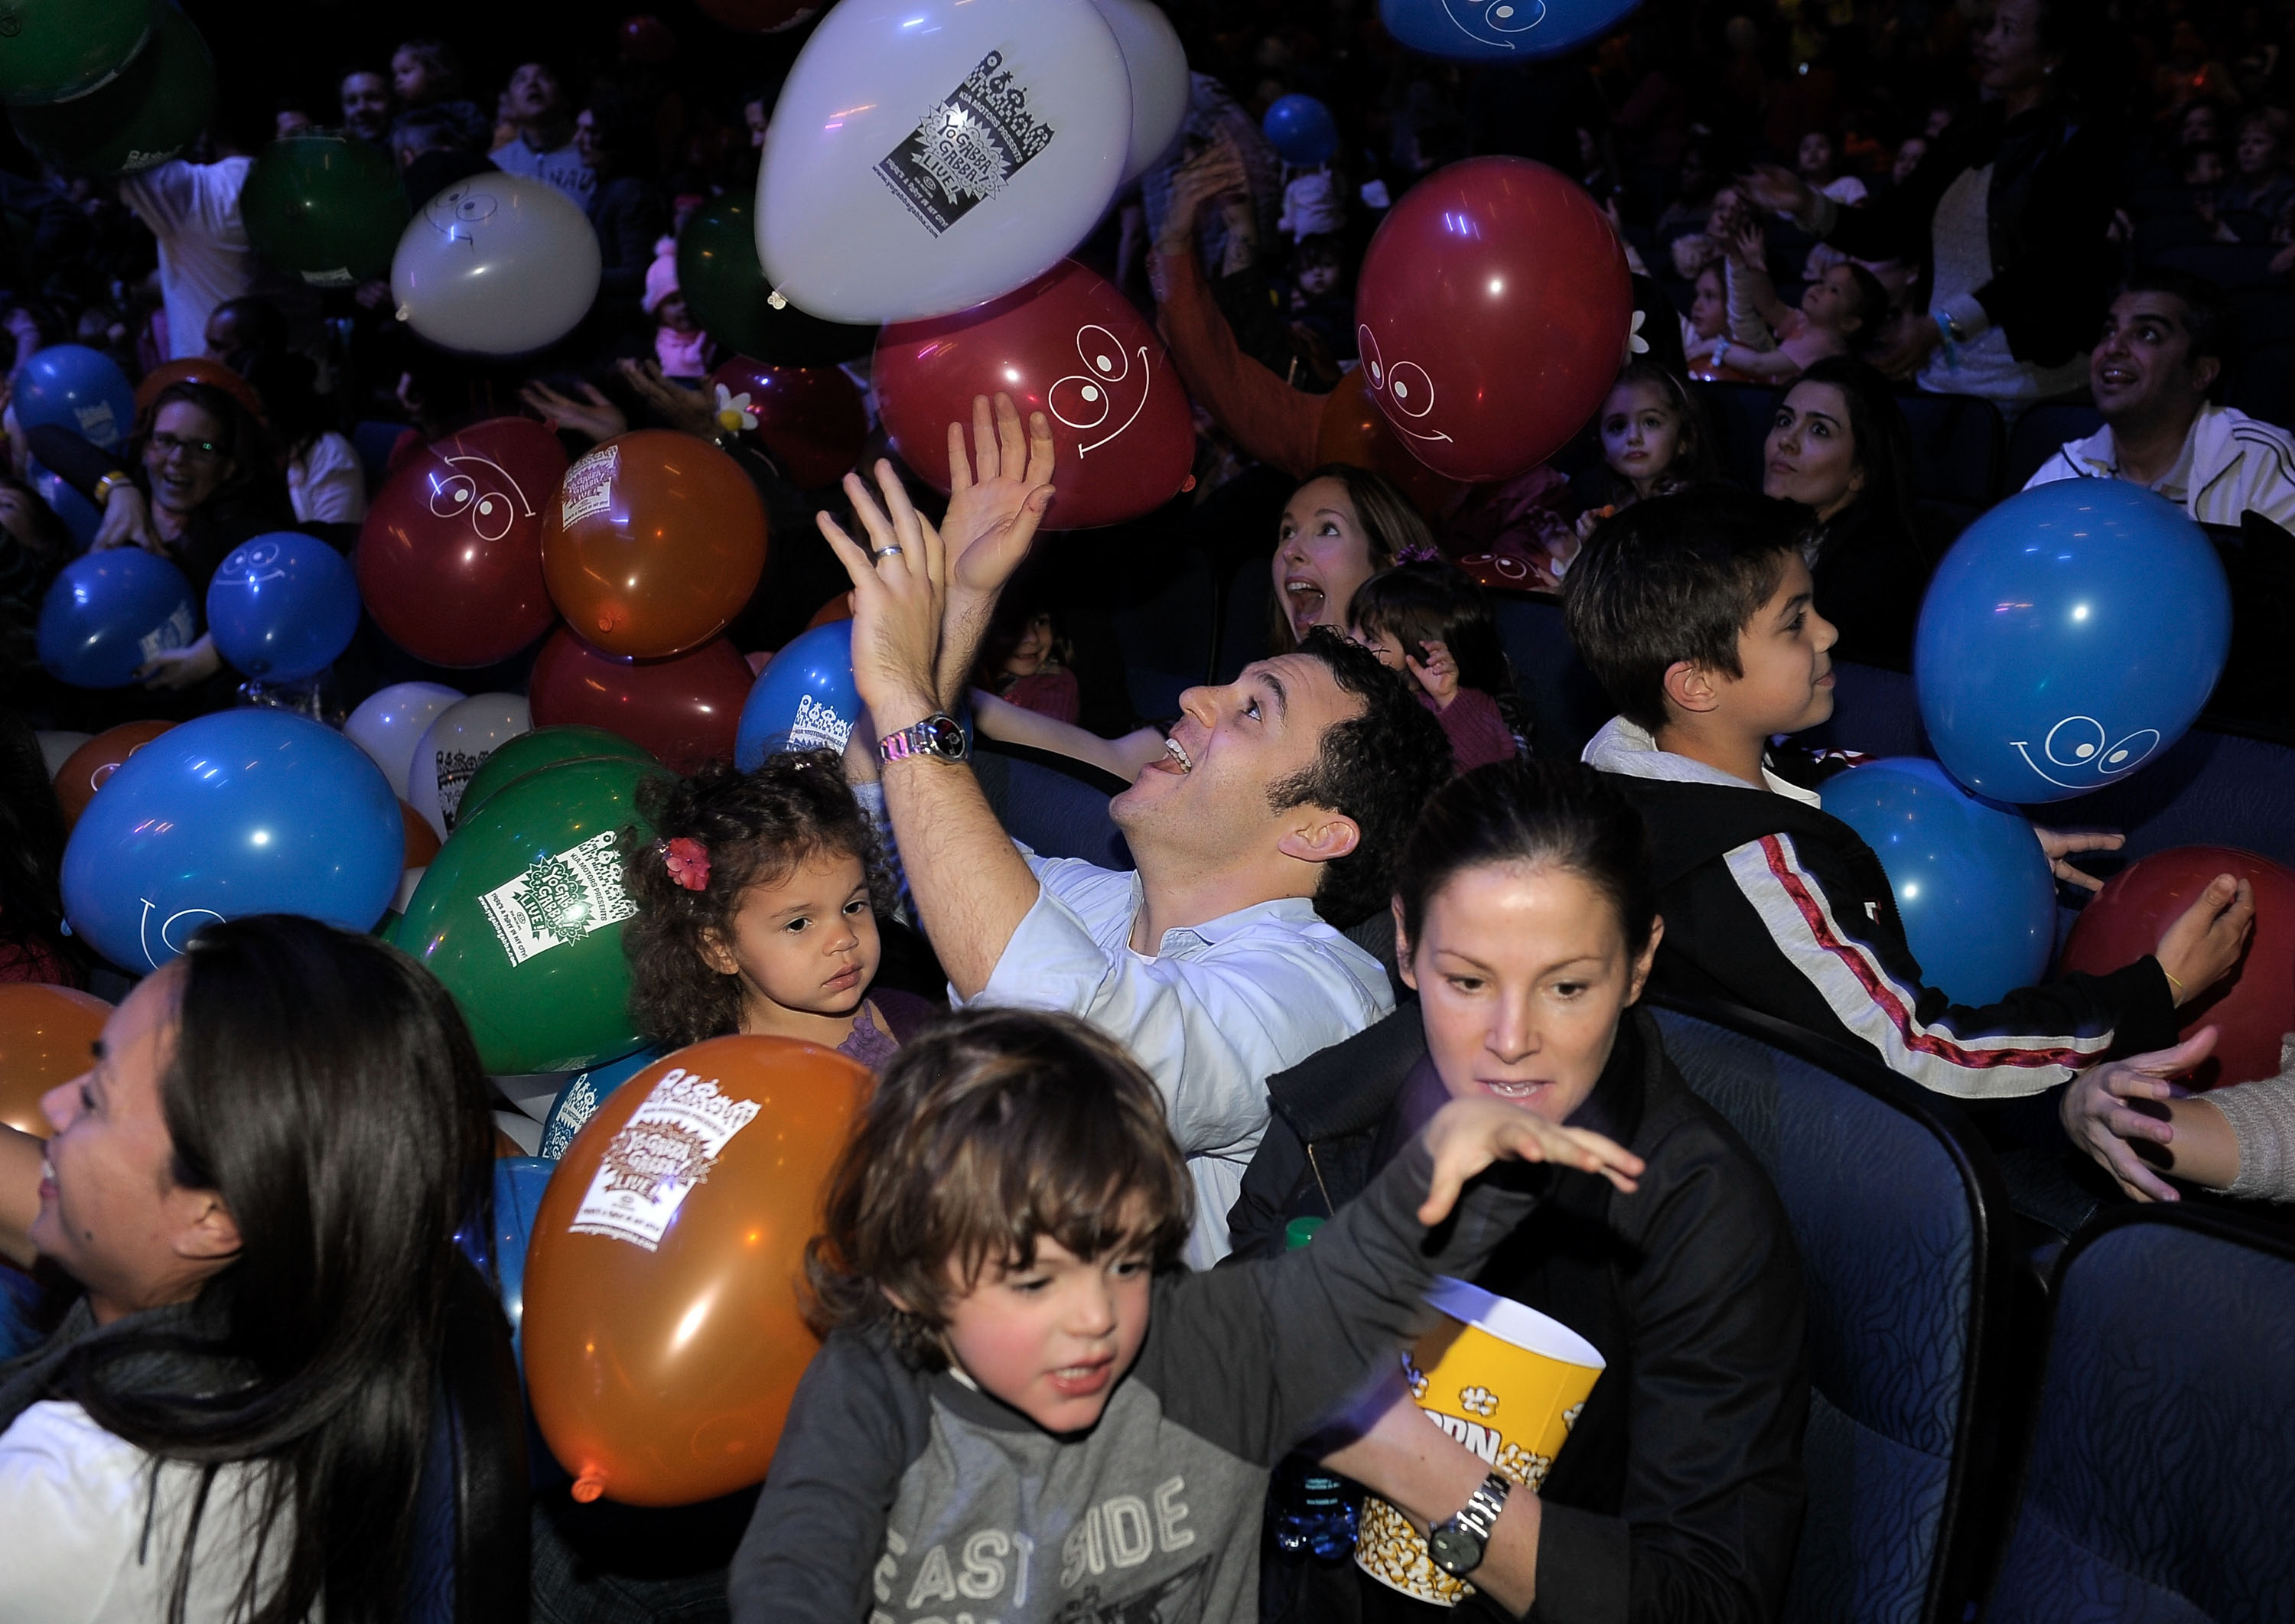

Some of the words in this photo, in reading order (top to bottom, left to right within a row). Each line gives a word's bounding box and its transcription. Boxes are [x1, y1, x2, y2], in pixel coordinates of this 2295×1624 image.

[956, 133, 991, 175] GABBA
[959, 91, 972, 104] KIA
[972, 99, 1001, 128] MOTORS
[998, 125, 1023, 163] PRESENTS
[923, 155, 959, 194] LIVE!
[939, 140, 989, 184] GABBA!
[872, 165, 938, 239] www.yogabbagabba.com
[520, 894, 545, 929] LIVE!
[570, 853, 581, 864] KIA
[579, 862, 597, 887] MOTORS
[594, 887, 607, 921] PRESENTS
[477, 895, 518, 968] www.yogabbagabba.com
[514, 935, 522, 945] MY
[1060, 1475, 1195, 1589] SIDE
